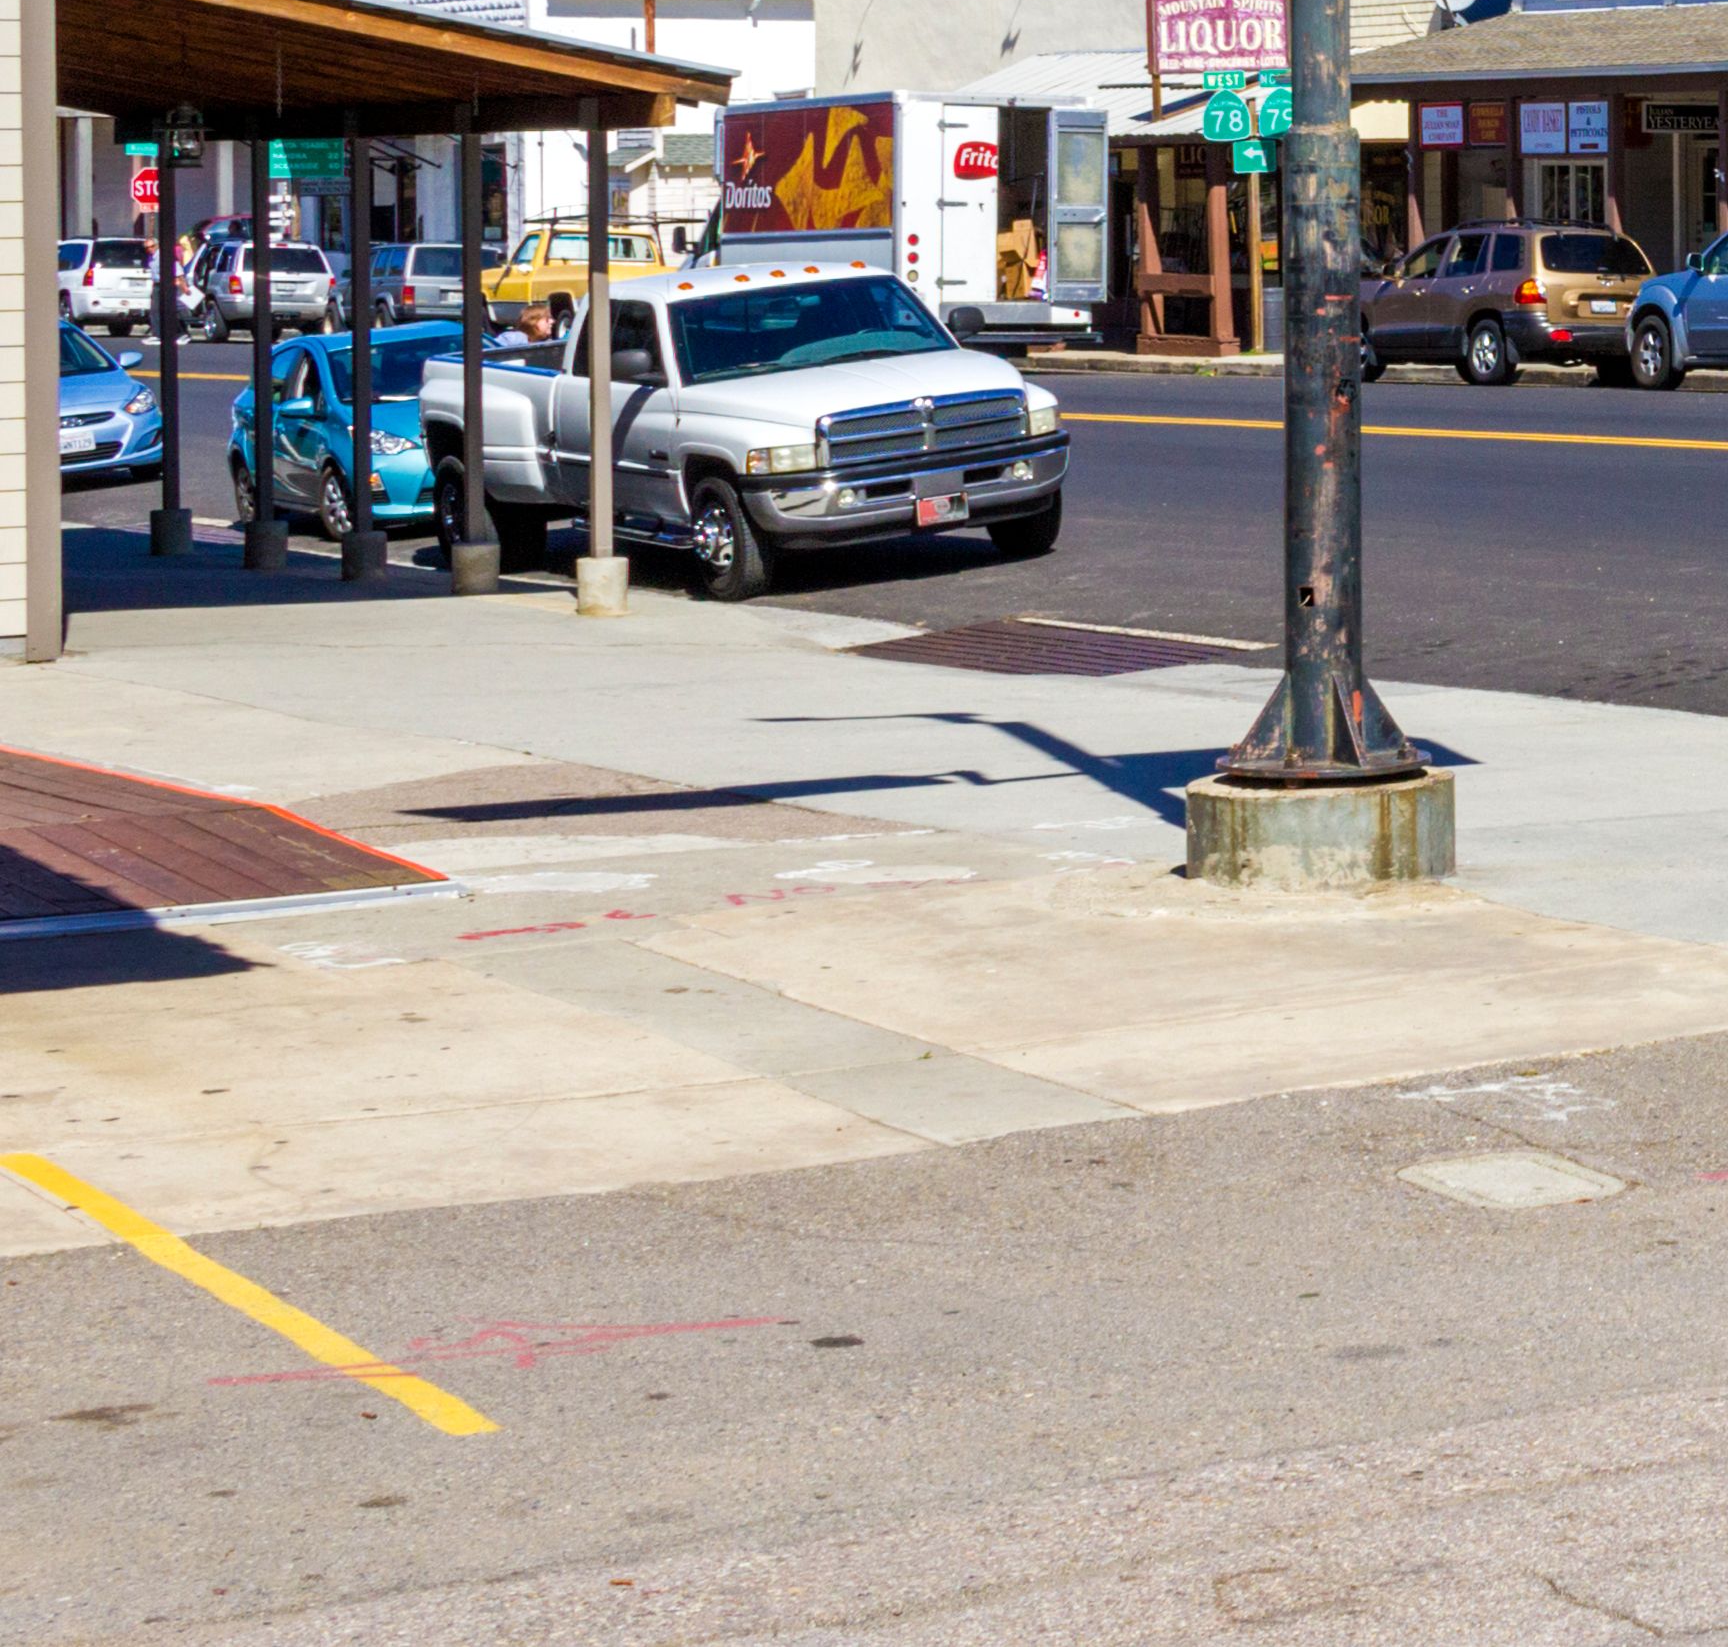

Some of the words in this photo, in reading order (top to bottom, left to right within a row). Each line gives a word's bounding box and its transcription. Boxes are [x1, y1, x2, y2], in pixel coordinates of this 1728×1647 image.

[1160, 17, 1284, 55] LIQUOR
[1206, 73, 1240, 87] WEST
[1210, 110, 1244, 133] 78
[1649, 115, 1719, 130] YESTERYEA
[725, 179, 773, 210] Doritos
